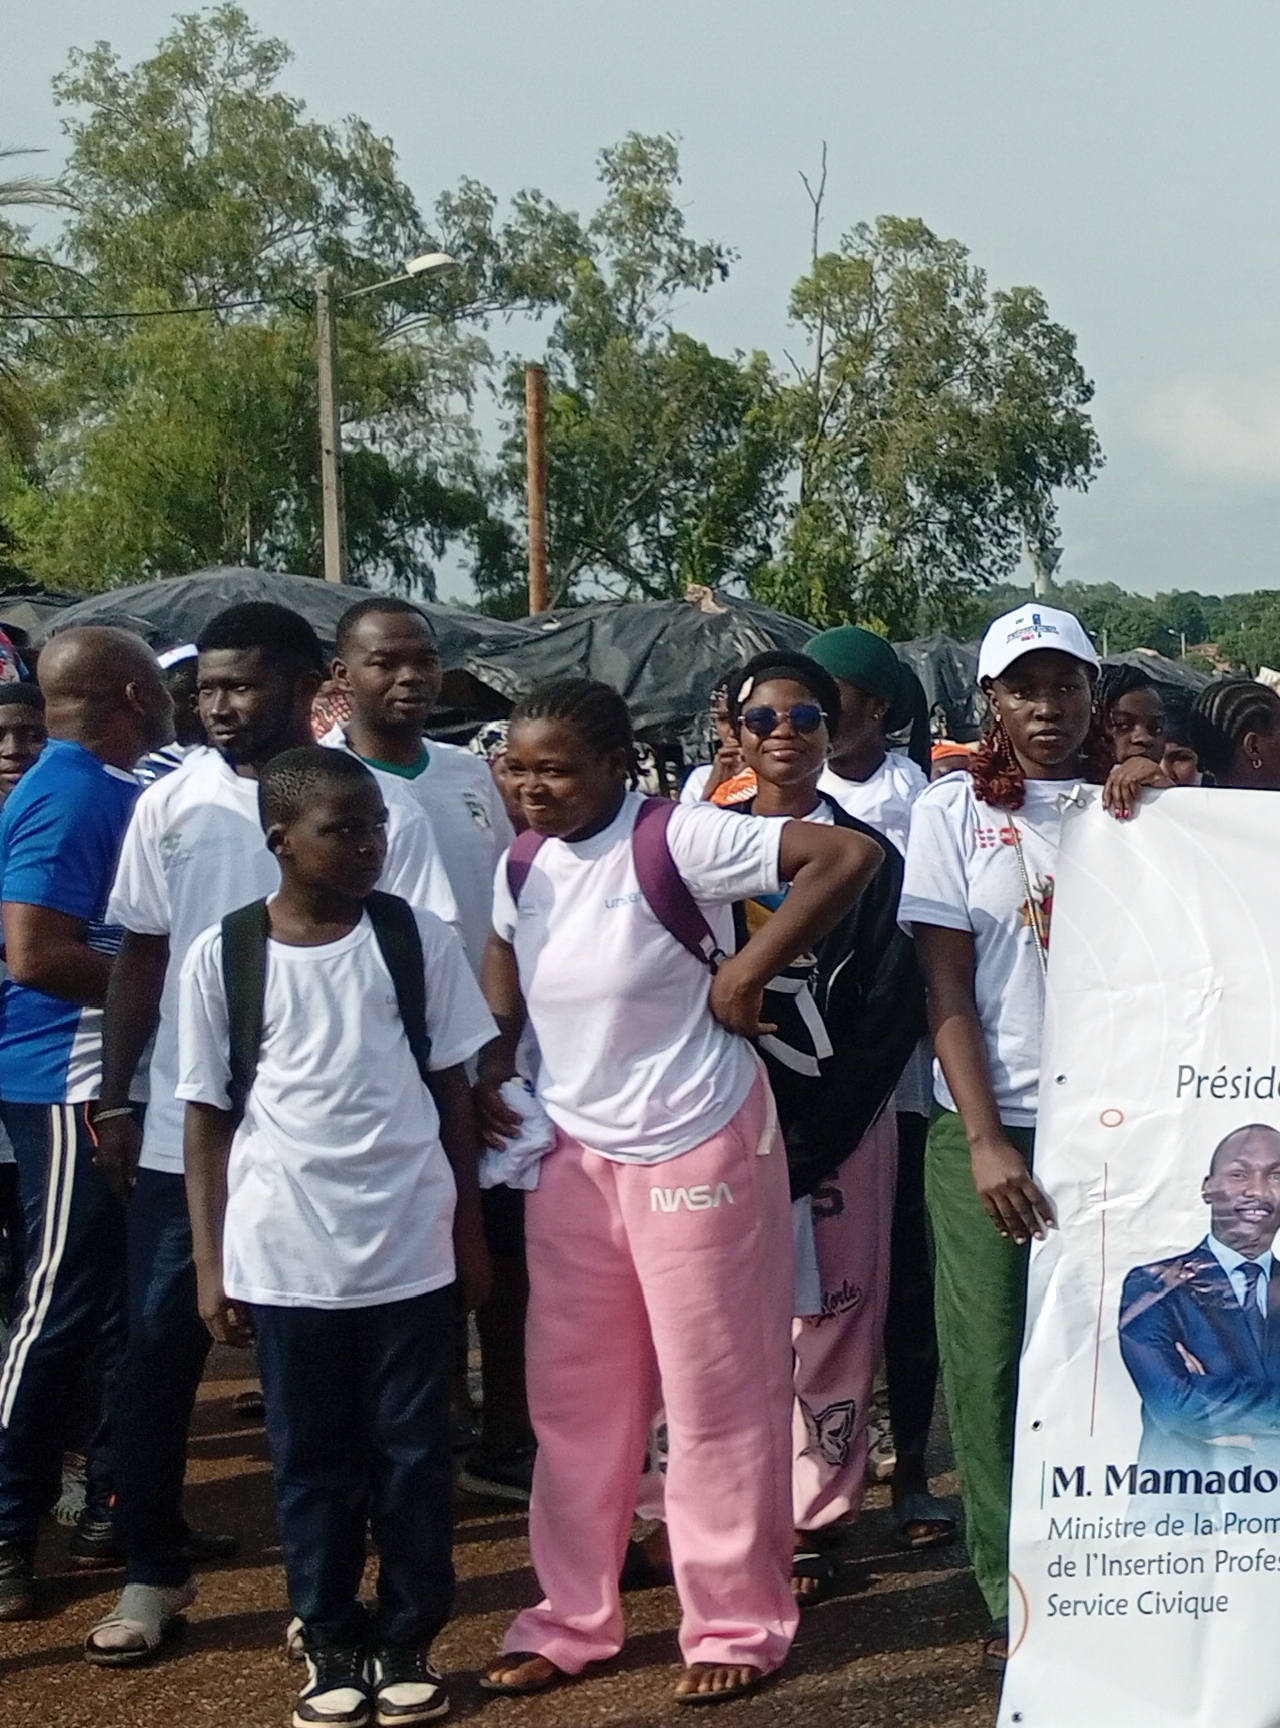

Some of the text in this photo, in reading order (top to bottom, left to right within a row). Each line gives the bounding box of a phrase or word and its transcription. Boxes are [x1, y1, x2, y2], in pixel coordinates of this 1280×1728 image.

[650, 1181, 734, 1213] NASA
[1051, 1466, 1094, 1501] M.
[1048, 1516, 1146, 1540] Ministre
[1155, 1513, 1184, 1536] de
[1194, 1513, 1212, 1535] la
[1048, 1555, 1076, 1577] de
[1086, 1552, 1204, 1576] l'Insertion
[1047, 1591, 1228, 1620] Service Civique
